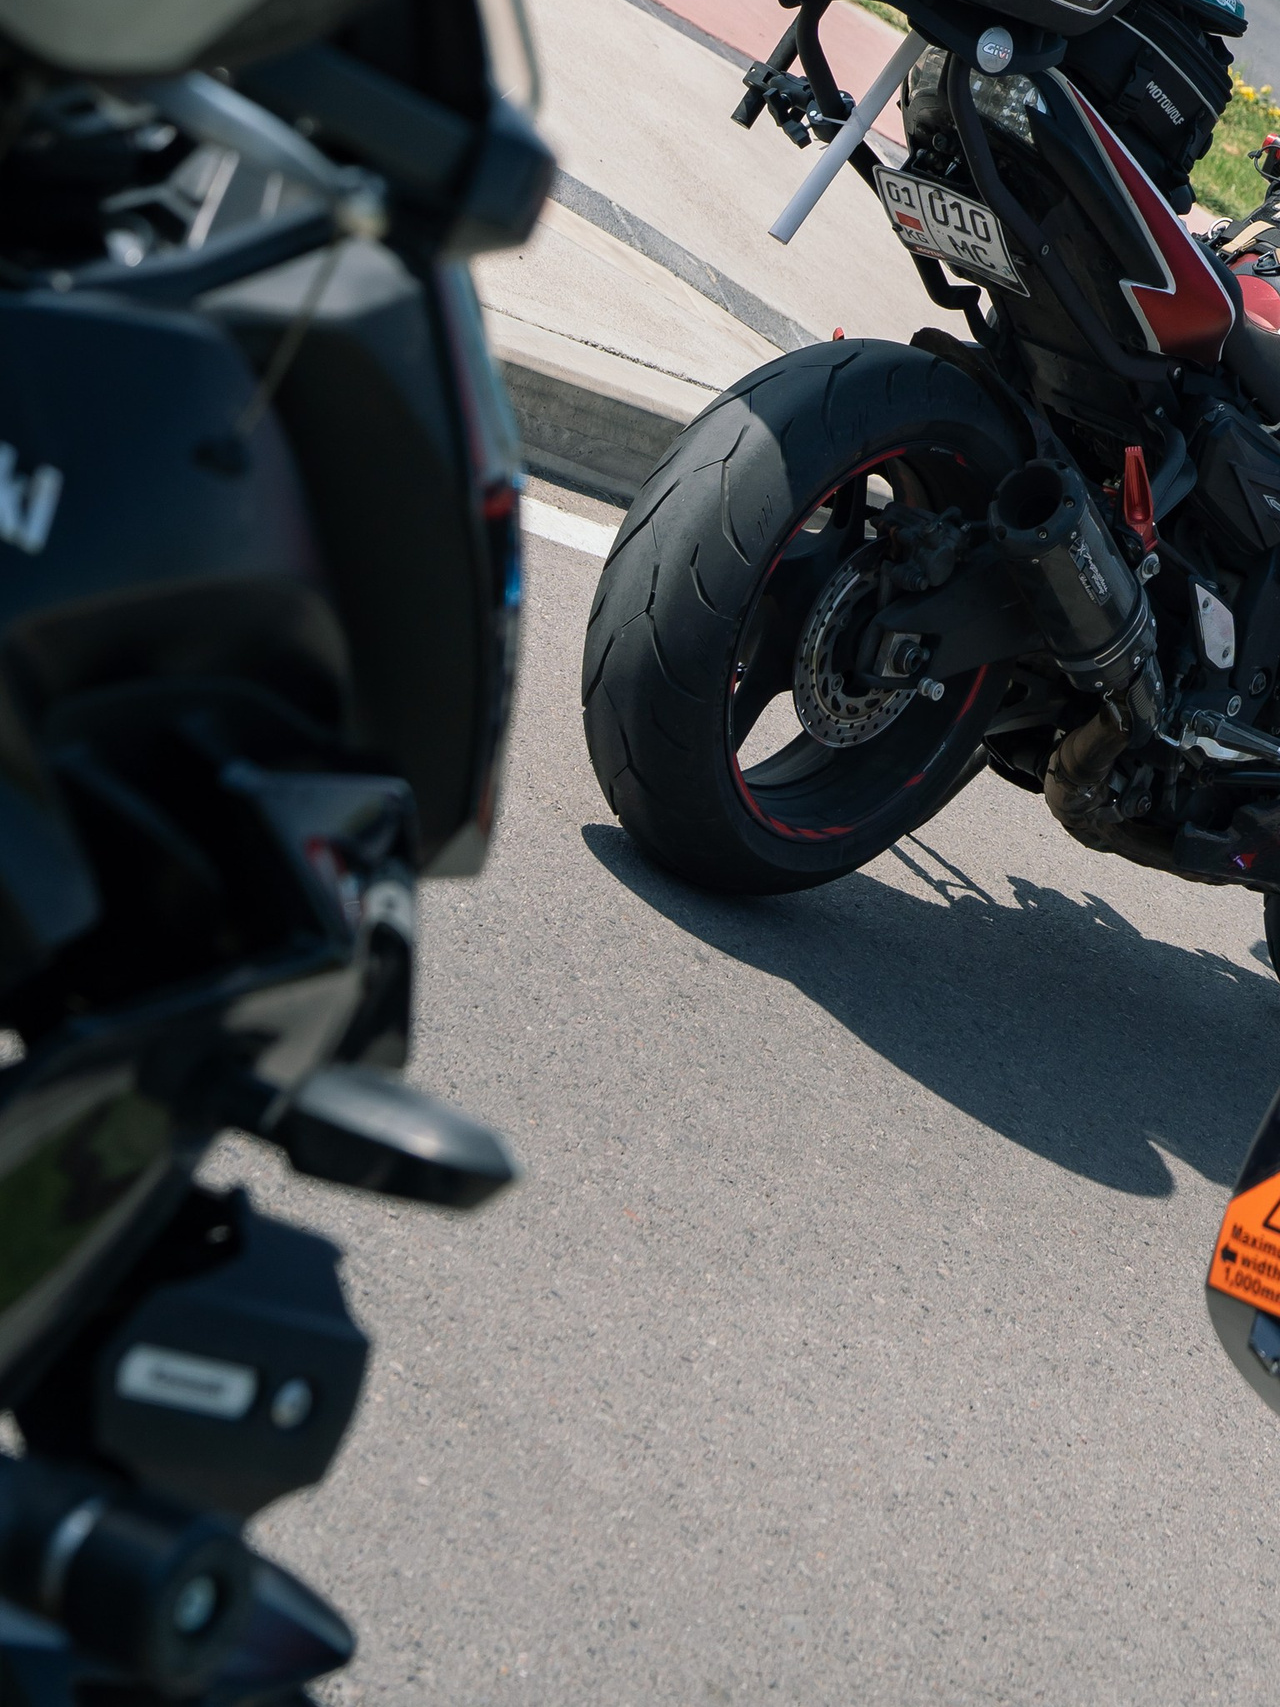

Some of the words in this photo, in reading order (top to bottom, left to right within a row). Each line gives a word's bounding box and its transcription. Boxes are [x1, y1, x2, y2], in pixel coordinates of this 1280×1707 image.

[983, 42, 1011, 60] GIVI
[1145, 79, 1185, 127] MOTOWOLF
[886, 180, 916, 209] 01
[928, 189, 992, 243] 010
[904, 228, 930, 245] KG
[947, 234, 996, 270] MC
